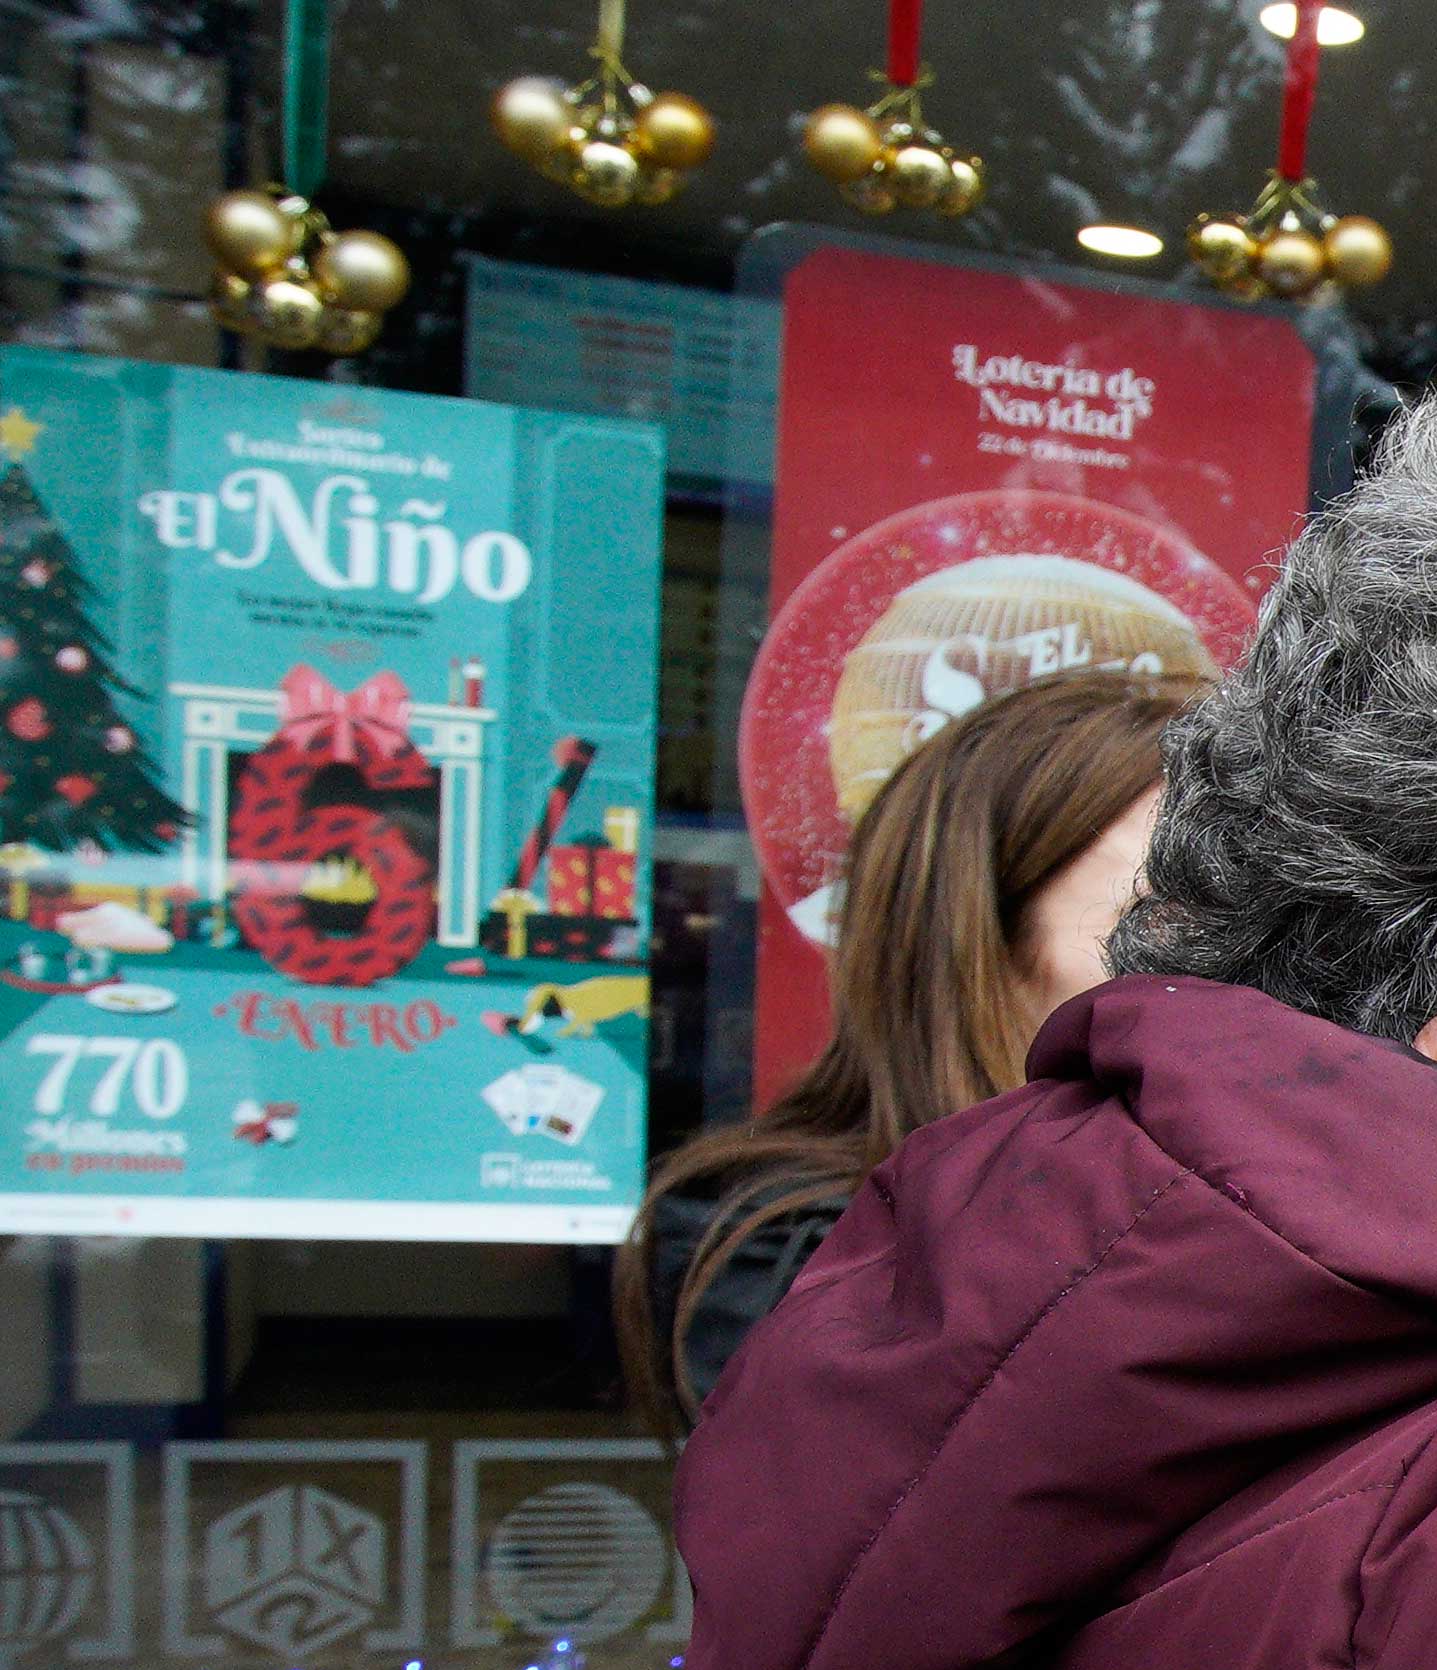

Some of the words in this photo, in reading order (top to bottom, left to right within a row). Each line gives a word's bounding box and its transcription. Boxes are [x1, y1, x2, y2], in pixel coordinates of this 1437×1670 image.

[978, 387, 1134, 441] Navidad
[215, 466, 534, 604] Niño
[25, 1033, 189, 1118] 770
